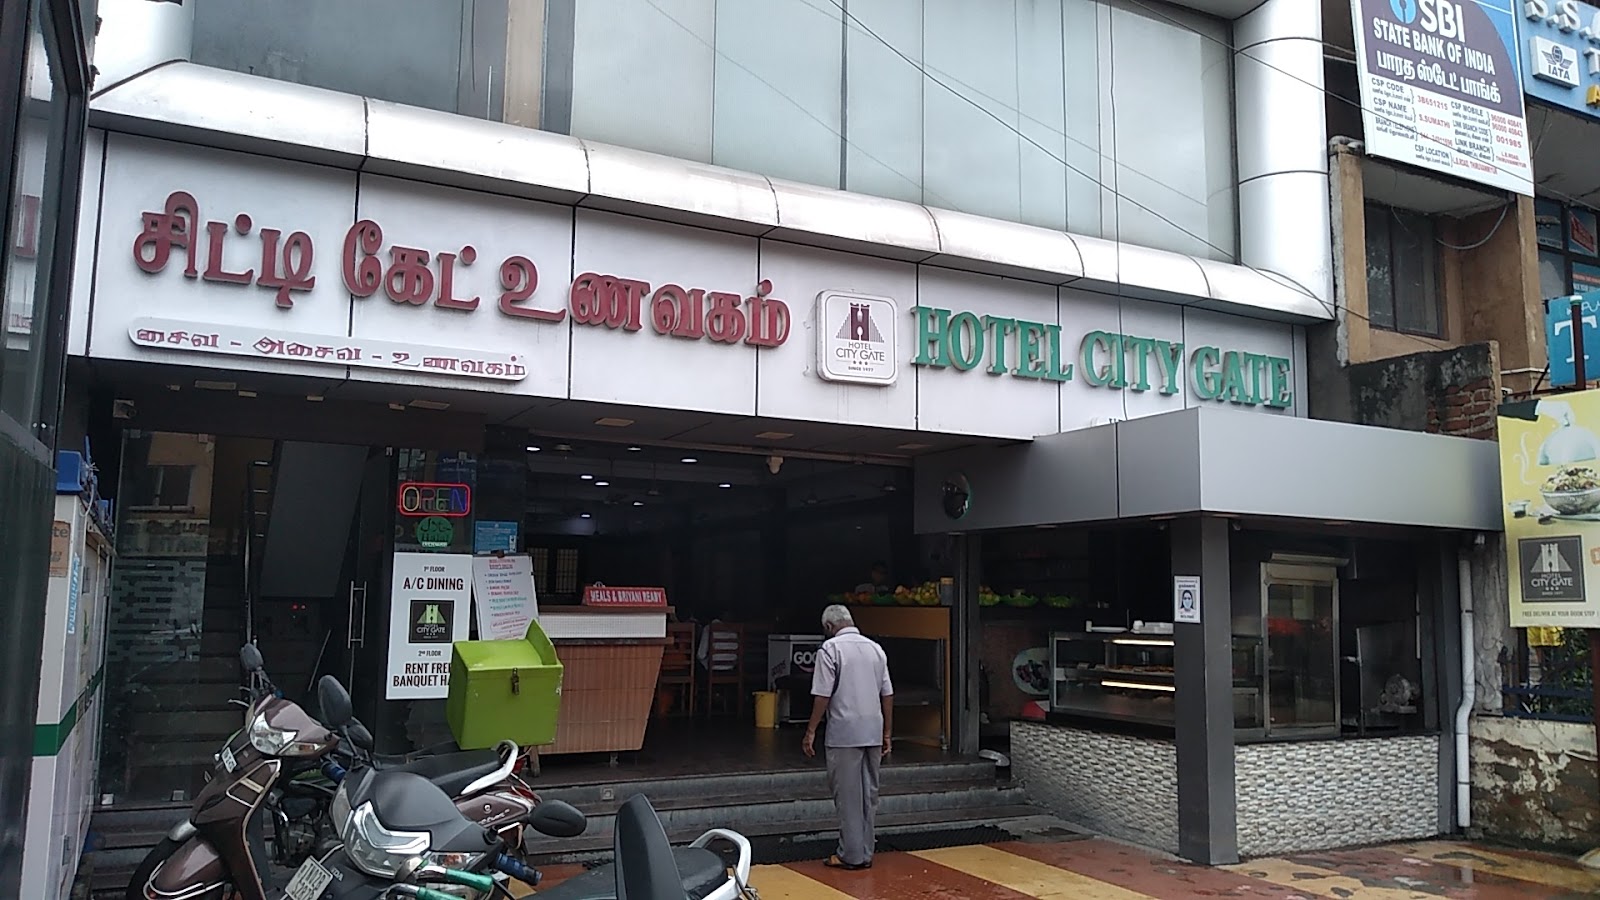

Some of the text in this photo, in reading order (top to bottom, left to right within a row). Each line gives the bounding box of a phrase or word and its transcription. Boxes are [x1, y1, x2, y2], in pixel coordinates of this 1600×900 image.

[1418, 0, 1466, 43] SBI
[1373, 17, 1496, 75] STATE BANK OF INDIA
[1376, 50, 1502, 104] பாரத ஸ்டேட் பாங்க்
[1548, 64, 1571, 80] IATA
[1371, 77, 1405, 94] CSP CODE
[1373, 97, 1408, 113] CSP NAME
[1450, 100, 1484, 117] CSP MOBILE
[1454, 137, 1468, 148] LINK
[1468, 141, 1491, 154] BRANCH
[1495, 134, 1523, 149] 001985
[133, 190, 791, 349] சிட்டி கேட் உணவகம்
[136, 327, 220, 348] சைவ
[253, 336, 362, 363] அசைவ
[392, 351, 526, 378] உணவகம்
[835, 347, 885, 361] CITY GATE
[848, 341, 873, 351] HOTEL
[910, 305, 1293, 409] HOTEL CITY GATE
[402, 486, 467, 512] OPEN
[403, 577, 464, 590] A/C DINING
[1531, 577, 1573, 588] CITY GATE
[416, 626, 445, 634] CITY GATE
[405, 662, 430, 675] RENT
[393, 675, 450, 688] BANQUET H
